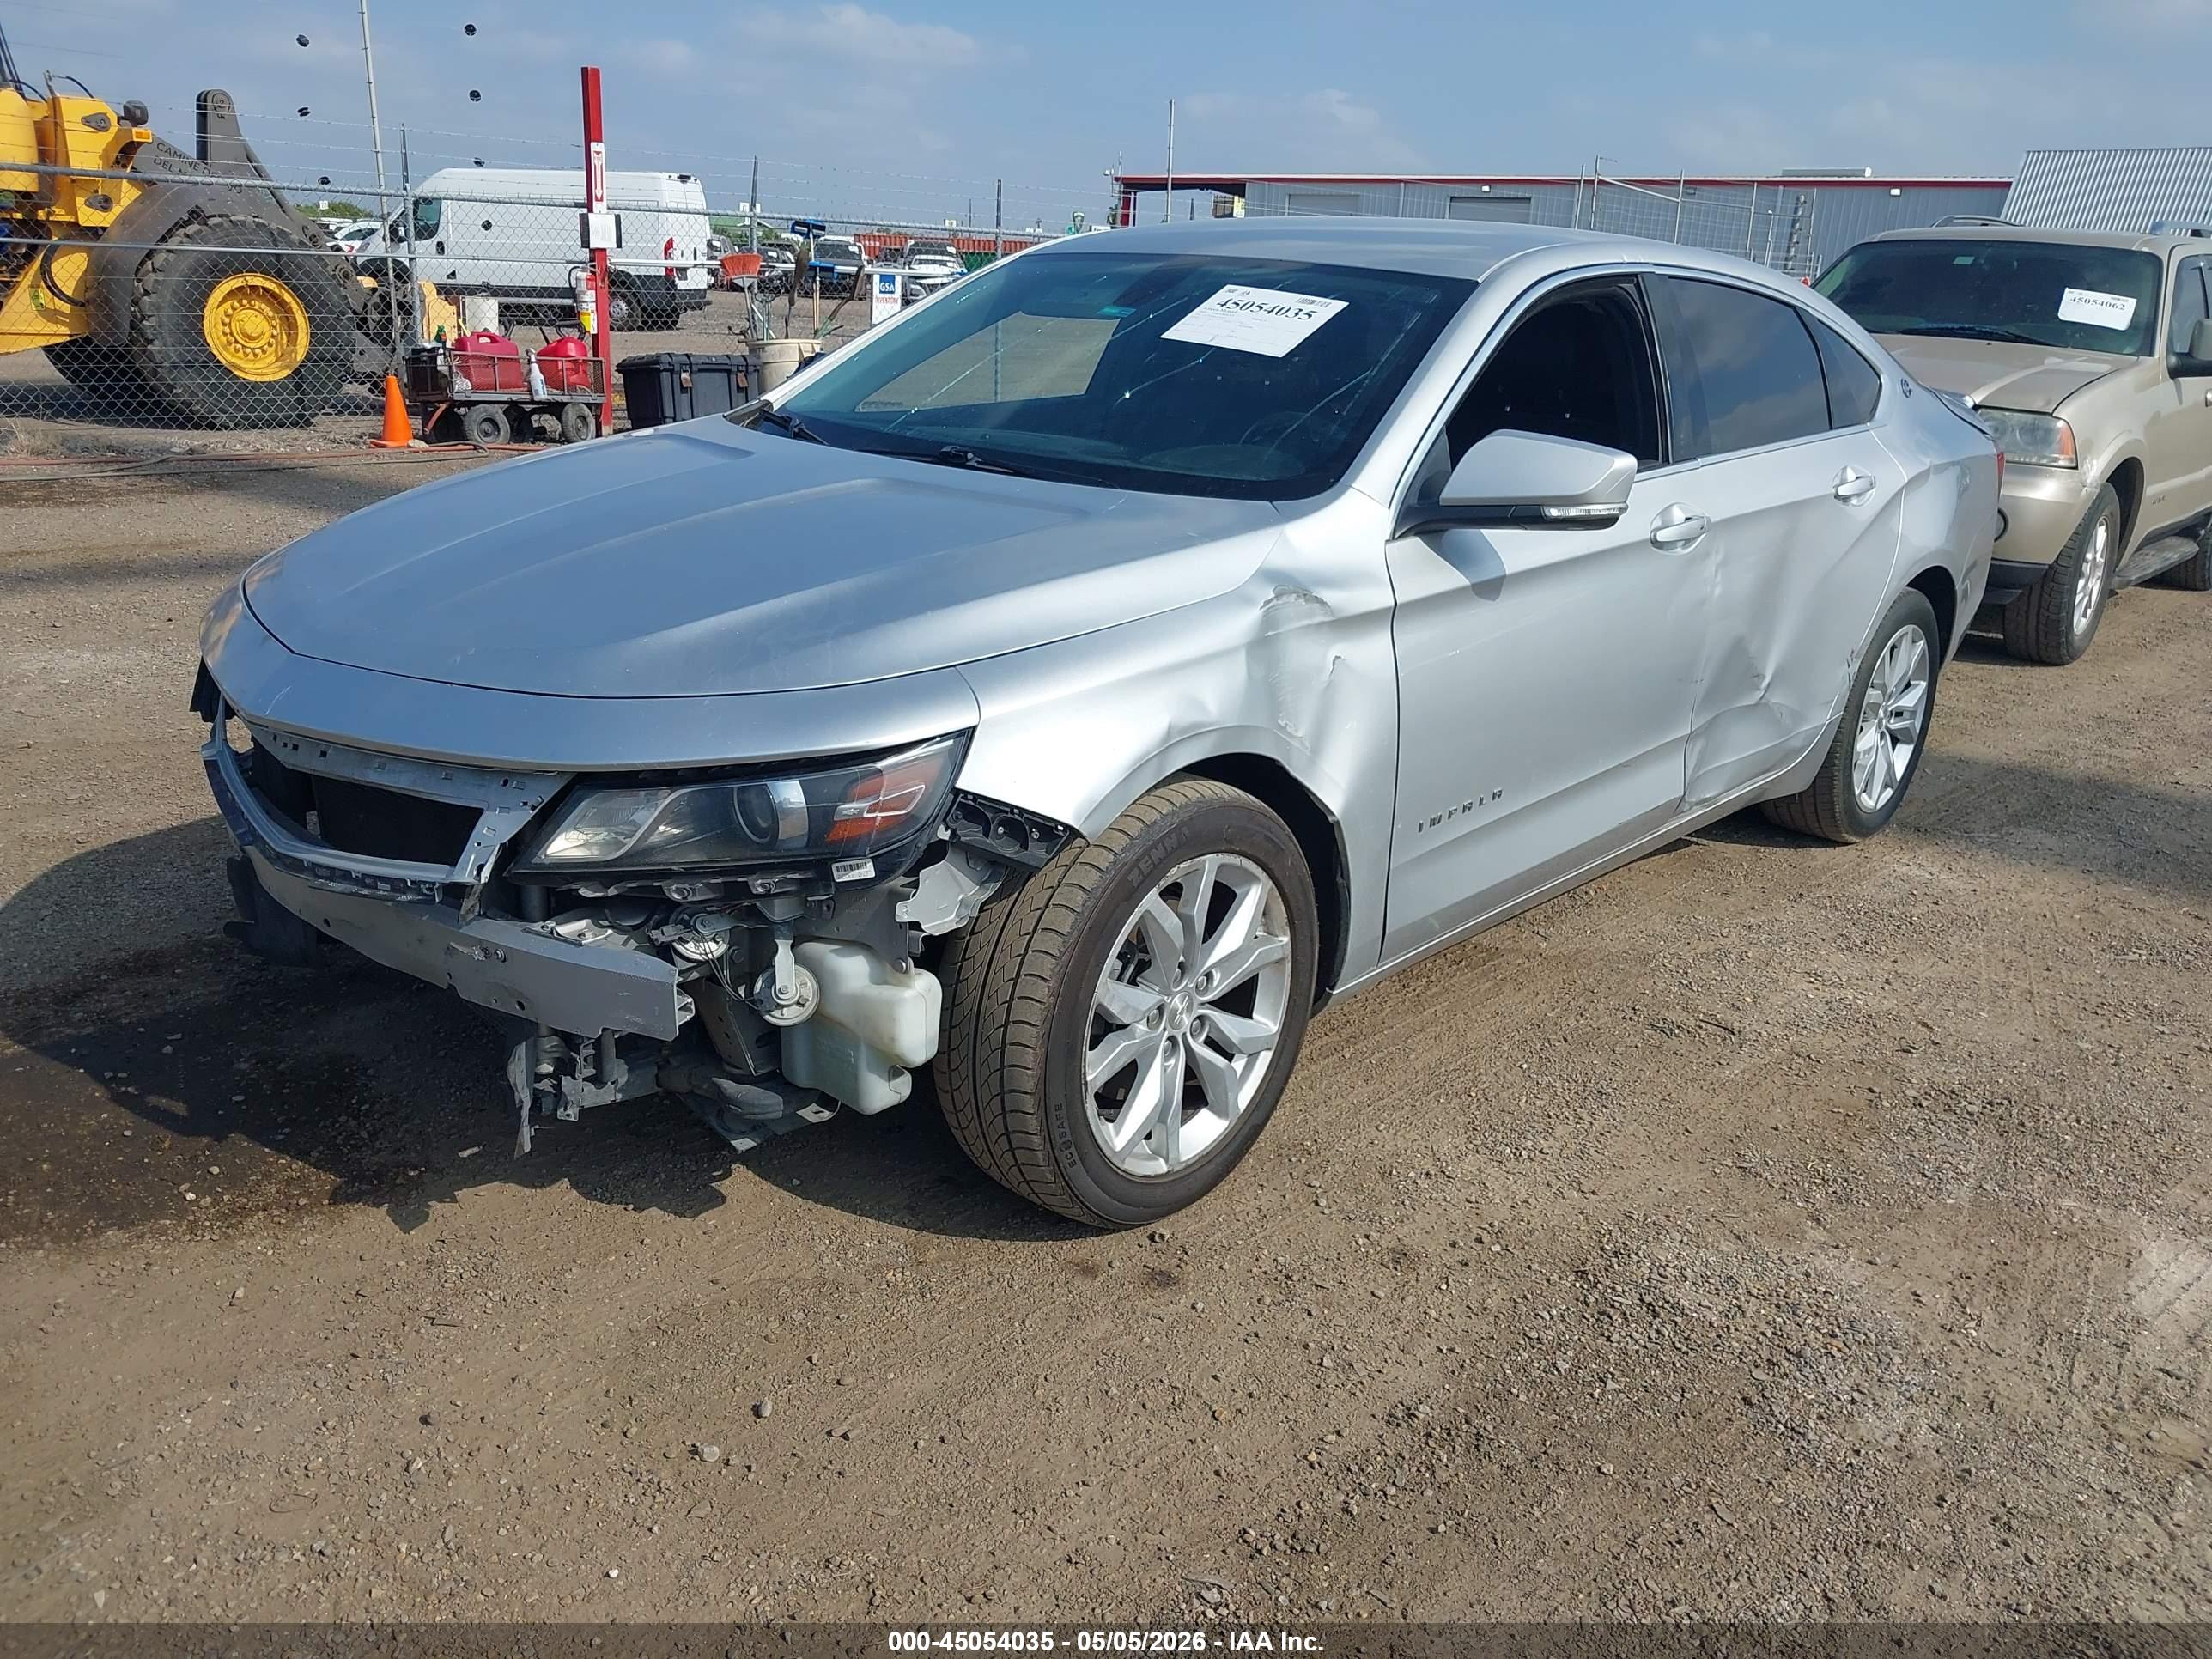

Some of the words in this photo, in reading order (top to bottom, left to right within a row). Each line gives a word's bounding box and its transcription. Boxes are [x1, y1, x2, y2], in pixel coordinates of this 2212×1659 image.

[156, 143, 200, 172] CAMINE
[879, 282, 895, 292] GSA
[1216, 298, 1317, 321] 45054035
[2069, 296, 2126, 311] 45054062
[1418, 788, 1503, 834] IMPALA
